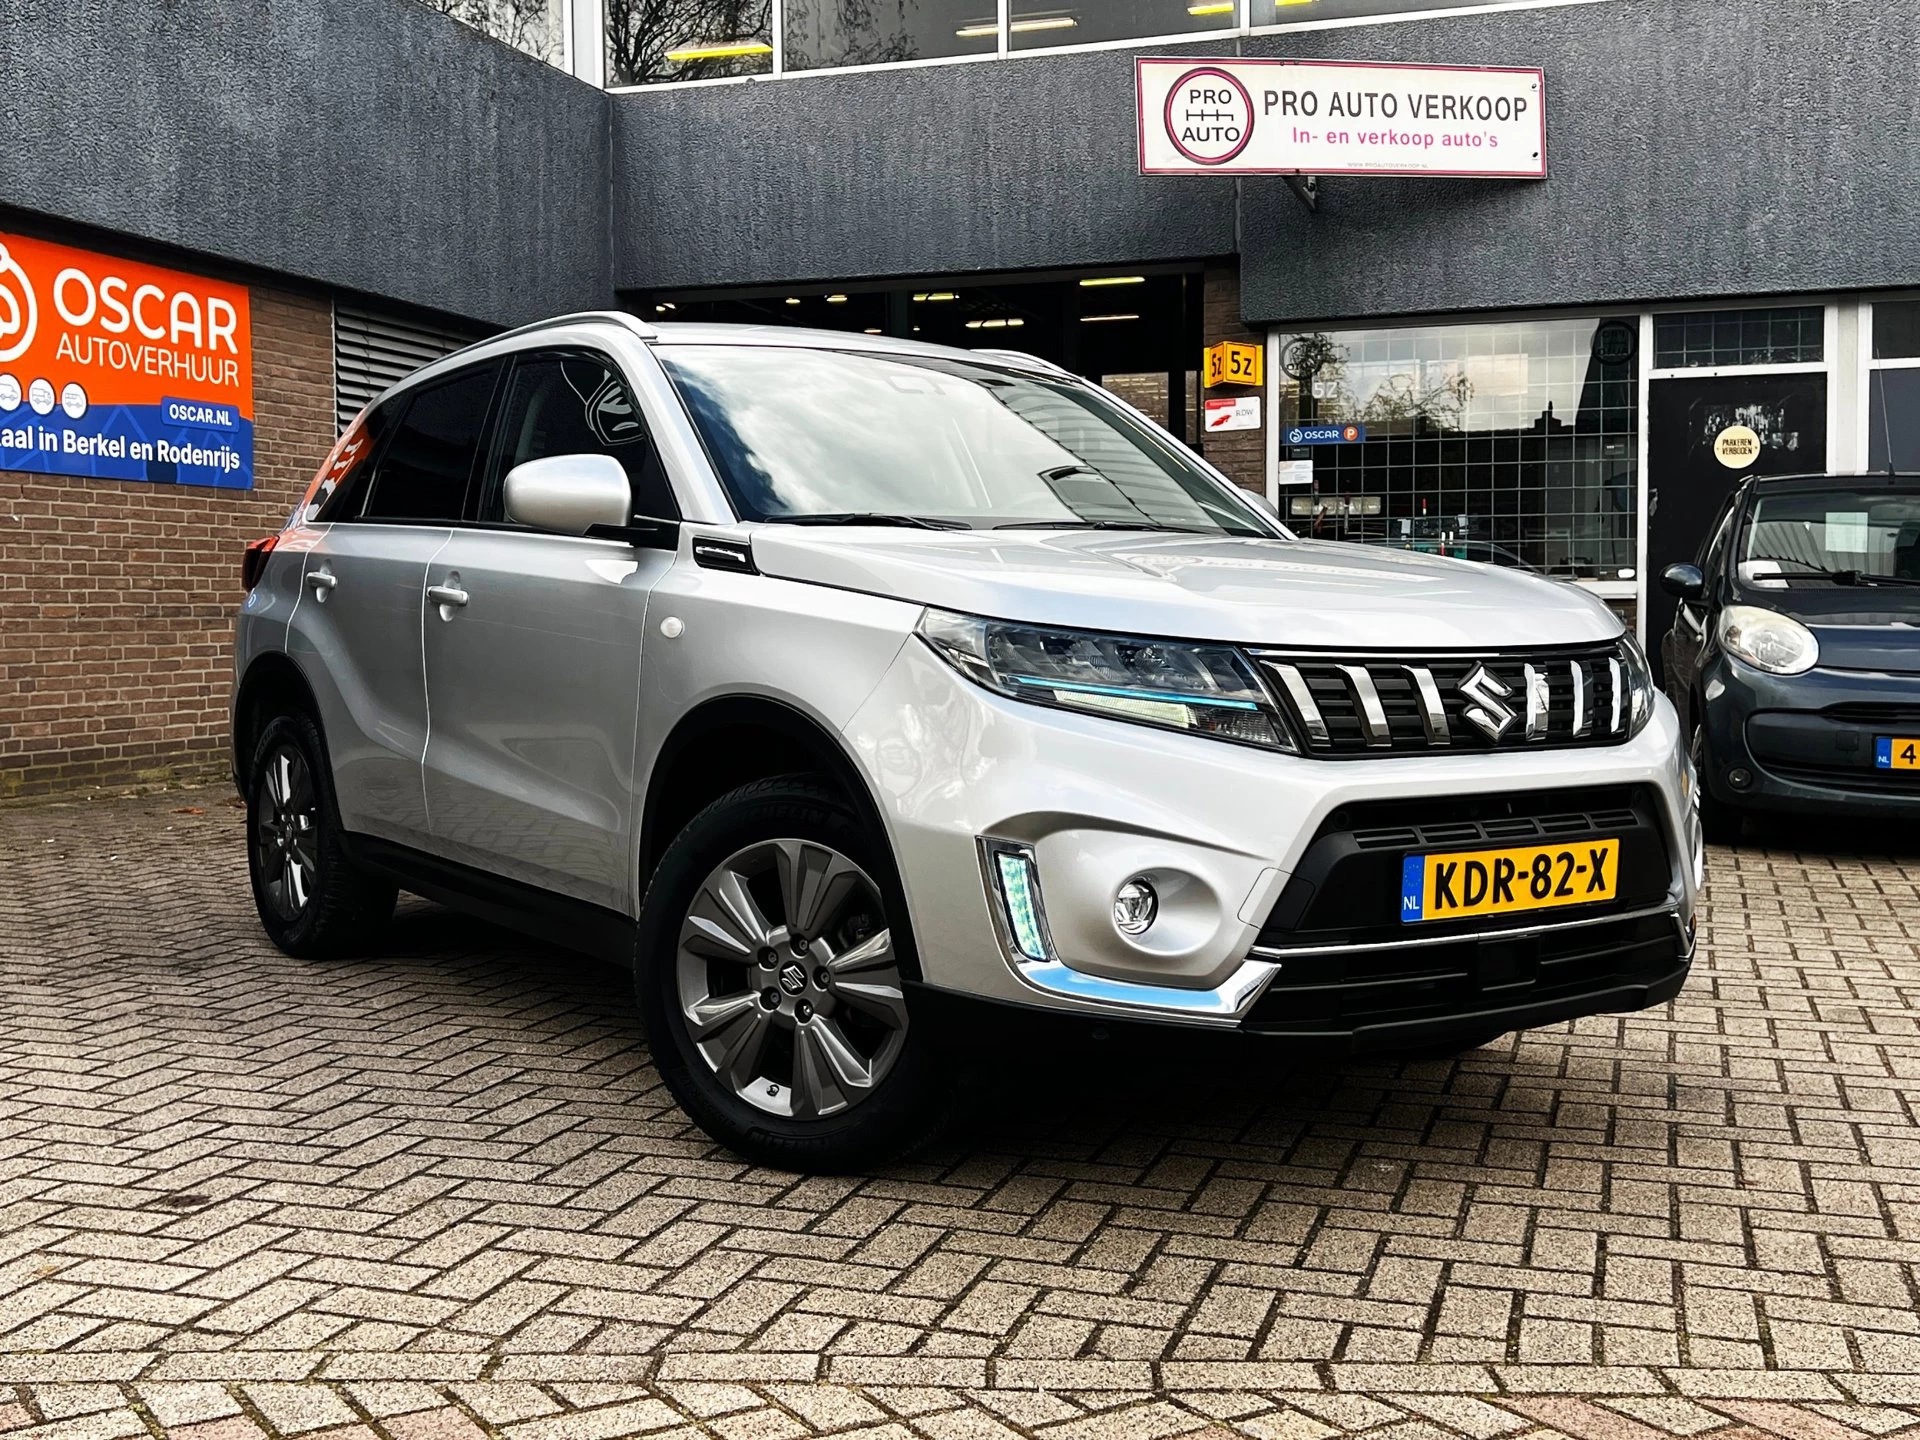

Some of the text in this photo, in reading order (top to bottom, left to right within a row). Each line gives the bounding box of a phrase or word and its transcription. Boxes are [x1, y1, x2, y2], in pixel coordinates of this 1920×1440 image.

[1189, 89, 1232, 104] PRO
[1264, 90, 1528, 122] PRO AUTO VERKOOP
[1181, 127, 1241, 143] AUTO
[1292, 127, 1499, 150] In- en verkoop auto's
[53, 268, 239, 355] OSCAR
[56, 332, 239, 387] AUTOVERHUUR
[168, 403, 233, 426] OSCAR.NL
[1304, 431, 1339, 439] OSCAR
[1722, 438, 1753, 447] PARKEREN
[0, 425, 240, 473] aal in Berkel en Rodenrijs
[1722, 447, 1753, 455] VERBODEN
[1434, 847, 1609, 911] KDR-82-X
[1403, 895, 1420, 911] NL
